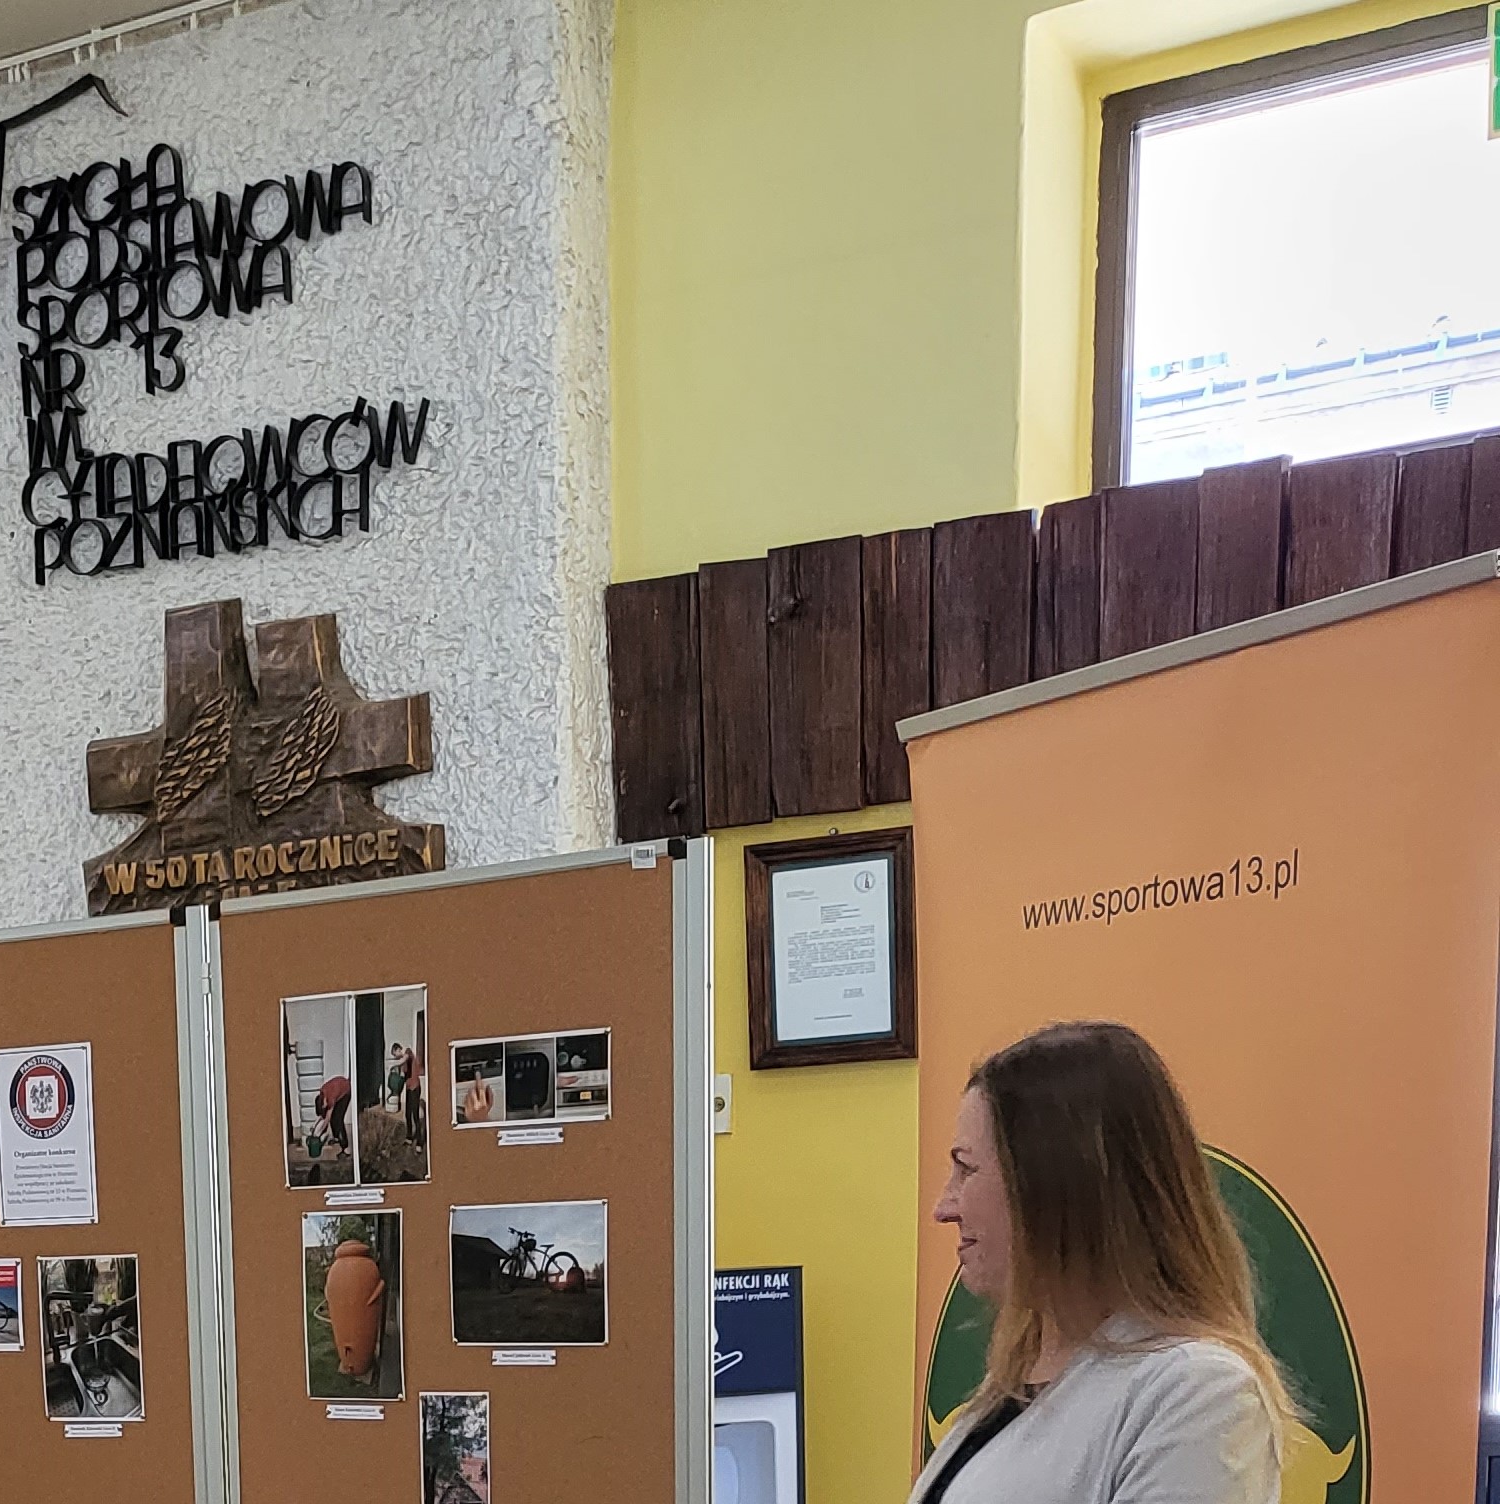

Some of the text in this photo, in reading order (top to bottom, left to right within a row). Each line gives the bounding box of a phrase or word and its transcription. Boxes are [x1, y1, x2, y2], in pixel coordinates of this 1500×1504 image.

[16, 162, 373, 306] PODSTAWOWA
[17, 244, 294, 360] SPORTOWA
[20, 326, 187, 418] NR 13
[103, 861, 138, 895] W
[145, 855, 188, 889] 50
[1022, 847, 1299, 930] www.sportowa13.pl
[19, 1056, 63, 1075] PAŃSTWOWA
[12, 1107, 43, 1138] INSPEKCJA
[43, 1104, 73, 1138] SANITARNA
[763, 1273, 790, 1290] RĄK
